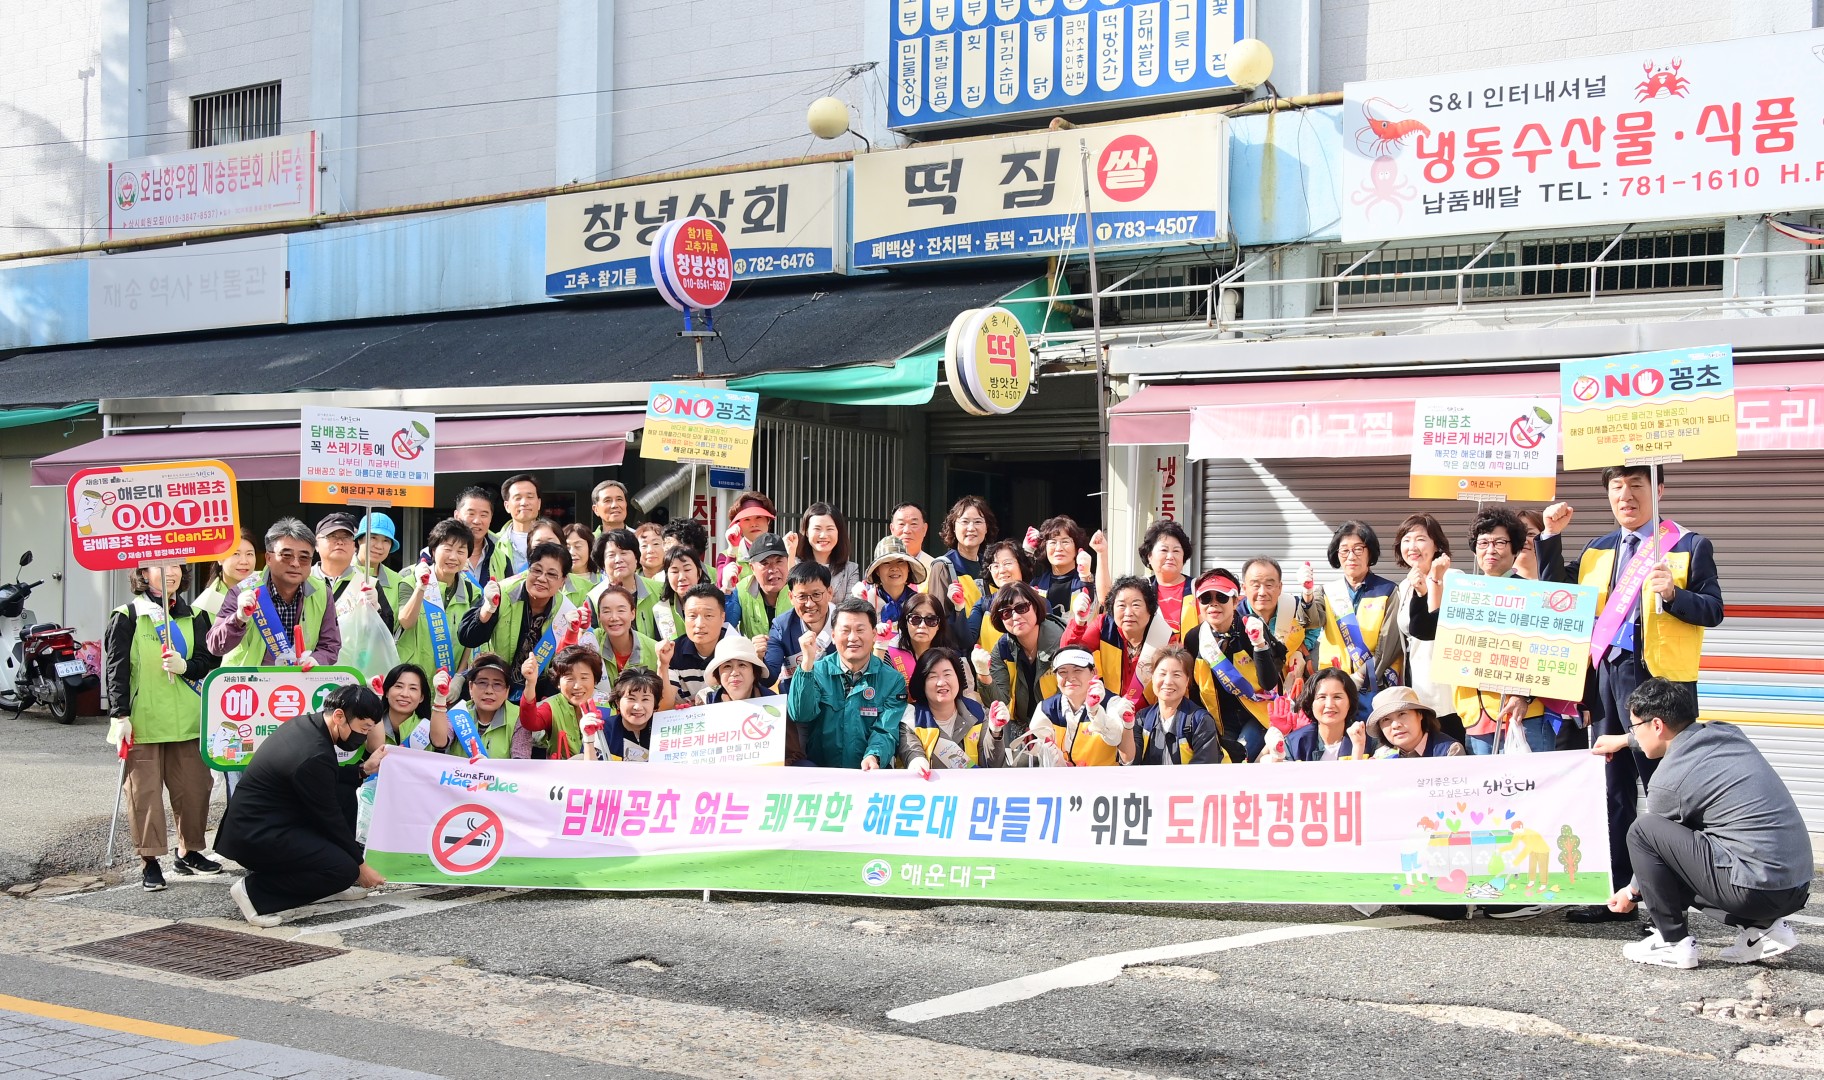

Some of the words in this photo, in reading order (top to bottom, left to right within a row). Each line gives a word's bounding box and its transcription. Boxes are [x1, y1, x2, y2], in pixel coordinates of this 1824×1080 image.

[1102, 14, 1118, 81] 떡방앗간
[1137, 9, 1154, 76] 김해쌀집
[902, 44, 916, 110] 민물장어
[1428, 91, 1473, 113] S&I
[1483, 75, 1608, 109] 인터내셔널
[140, 163, 198, 202] 호남향우회
[202, 153, 263, 197] 재송동문회
[268, 147, 305, 185] 사무실
[1102, 146, 1152, 190] 쌀
[904, 157, 964, 215] 떡
[998, 147, 1061, 210] 집
[1422, 186, 1522, 215] 납품배달
[1619, 166, 1760, 198] 781-1610
[582, 183, 789, 252] 창녕상회
[1114, 215, 1198, 239] 783-4507
[687, 226, 713, 241] 참기름
[685, 240, 718, 254] 고추가루
[676, 253, 729, 279] 창녕상회
[748, 252, 815, 272] 782-6476
[103, 278, 142, 310] 재송
[149, 274, 193, 306] 역사
[200, 266, 268, 301] 박물관
[987, 334, 1017, 378] 떡
[989, 377, 1019, 389] 방앗간
[1668, 364, 1722, 391] 꽁초
[987, 390, 1021, 400] 783-4507
[716, 402, 752, 421] 꽁초
[1424, 415, 1471, 429] 담배꽁초
[310, 424, 369, 440] 담배꽁초는
[1291, 411, 1393, 444] 아구찜
[1423, 431, 1470, 445] 올바르게
[1473, 432, 1508, 446] 버리기
[326, 441, 385, 456] 쓰레기통에
[1635, 441, 1672, 452] 해운대구
[117, 484, 163, 501] 해운대
[167, 480, 226, 497] 담배꽁초
[340, 485, 374, 495] 해운대구
[82, 537, 134, 552] 담배꽁초
[137, 533, 162, 547] 없는
[165, 528, 226, 544] Clean도시
[1450, 590, 1491, 606] 담배꽁초
[1446, 606, 1484, 622] 담배꽁초
[1488, 610, 1507, 624] 없는
[1510, 612, 1550, 629] 아름다운
[1552, 617, 1584, 632] 해운대
[1454, 633, 1522, 652] 미세플라스틱
[1529, 643, 1570, 658] 해양오염
[1443, 647, 1482, 663] 토양오염
[1489, 653, 1530, 670] 화재원인
[1537, 658, 1578, 676] 침수원인
[1474, 667, 1512, 681] 해운대구
[1515, 671, 1551, 686] 재송2동
[658, 734, 705, 752] 올바르게
[707, 730, 741, 745] 버리기
[660, 721, 706, 738] 담배꽁초
[454, 769, 495, 781] Sun&Fun
[1483, 774, 1535, 796] 해운대
[689, 791, 750, 835] 없는
[758, 789, 853, 833] 쾌적한
[862, 792, 958, 839] 해운대
[1091, 792, 1153, 846] 위한
[1164, 790, 1363, 847] 도시환경정비
[900, 862, 997, 888] 해운대구
